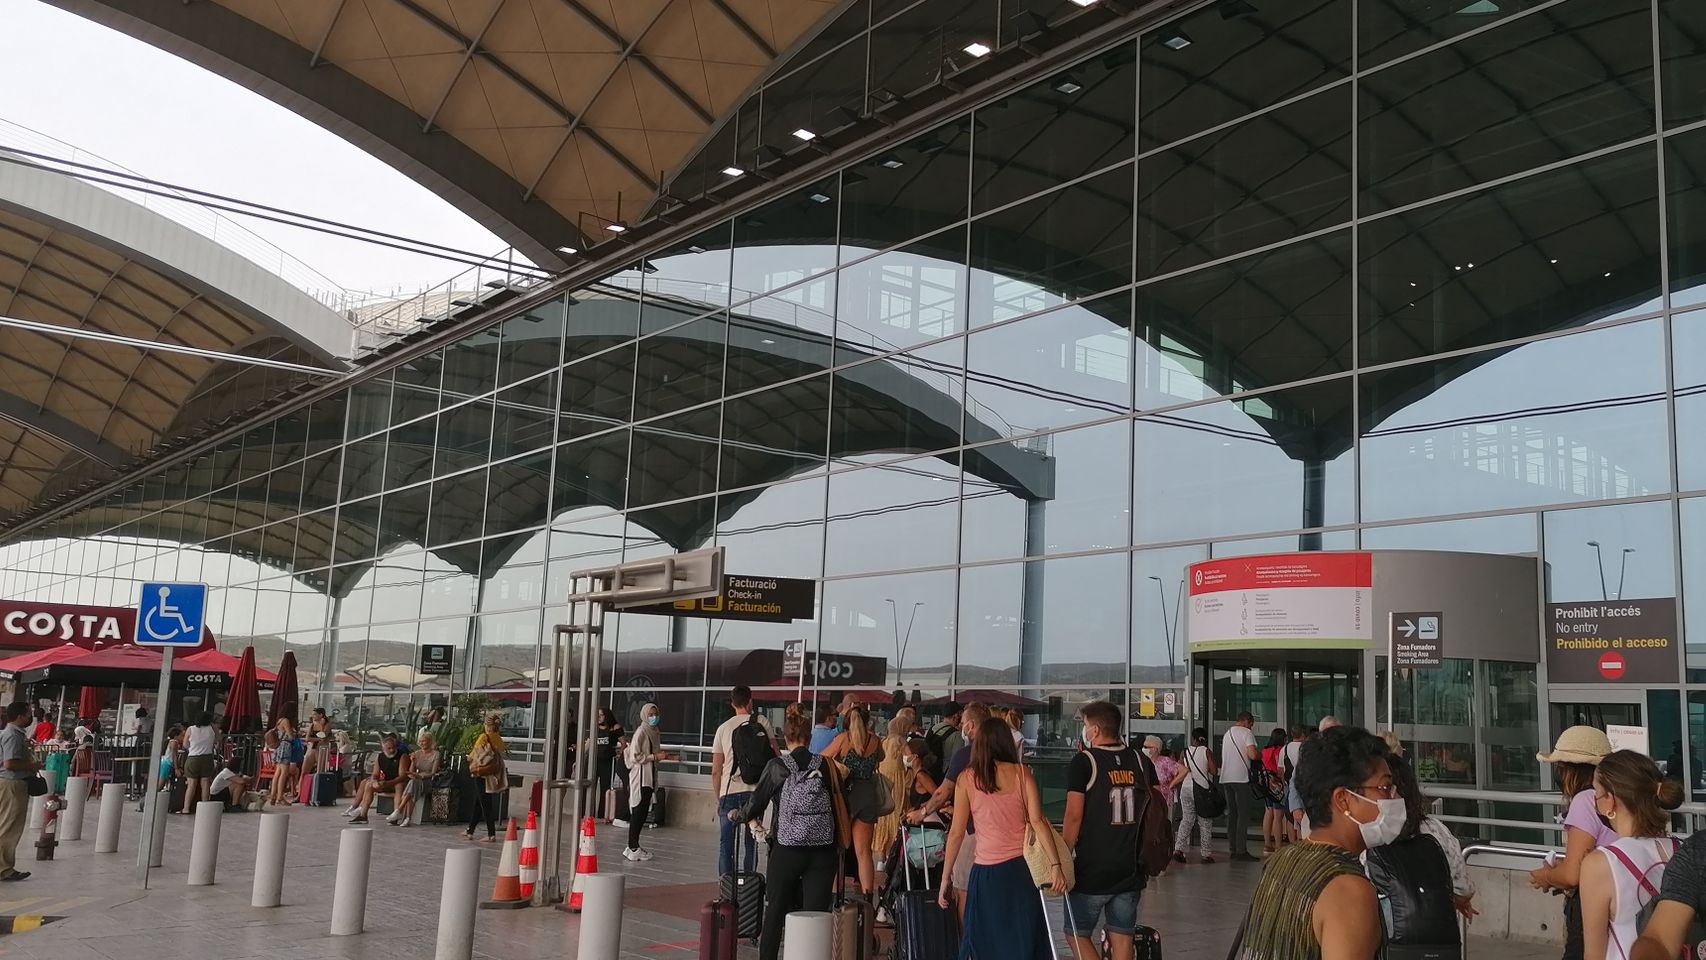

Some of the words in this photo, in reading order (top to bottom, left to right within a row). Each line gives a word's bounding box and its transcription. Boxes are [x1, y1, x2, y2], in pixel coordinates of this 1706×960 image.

[729, 577, 777, 589] Facturació
[728, 589, 762, 599] Check-in
[728, 600, 782, 613] Facturación
[1555, 607, 1598, 619] Prohibit
[1600, 605, 1641, 617] l'accés
[3, 610, 121, 641] COSTA
[1555, 622, 1570, 633] No
[1572, 622, 1599, 635] entry
[1396, 643, 1410, 651] Zona
[1556, 637, 1609, 649] Prohibido
[1612, 637, 1623, 648] el
[1626, 638, 1668, 648] acceso
[1396, 657, 1410, 665] Zona
[1410, 657, 1440, 665] Fumadores
[187, 674, 222, 683] COSTA
[1107, 770, 1135, 785] YOUNG
[1109, 786, 1136, 825] 11
